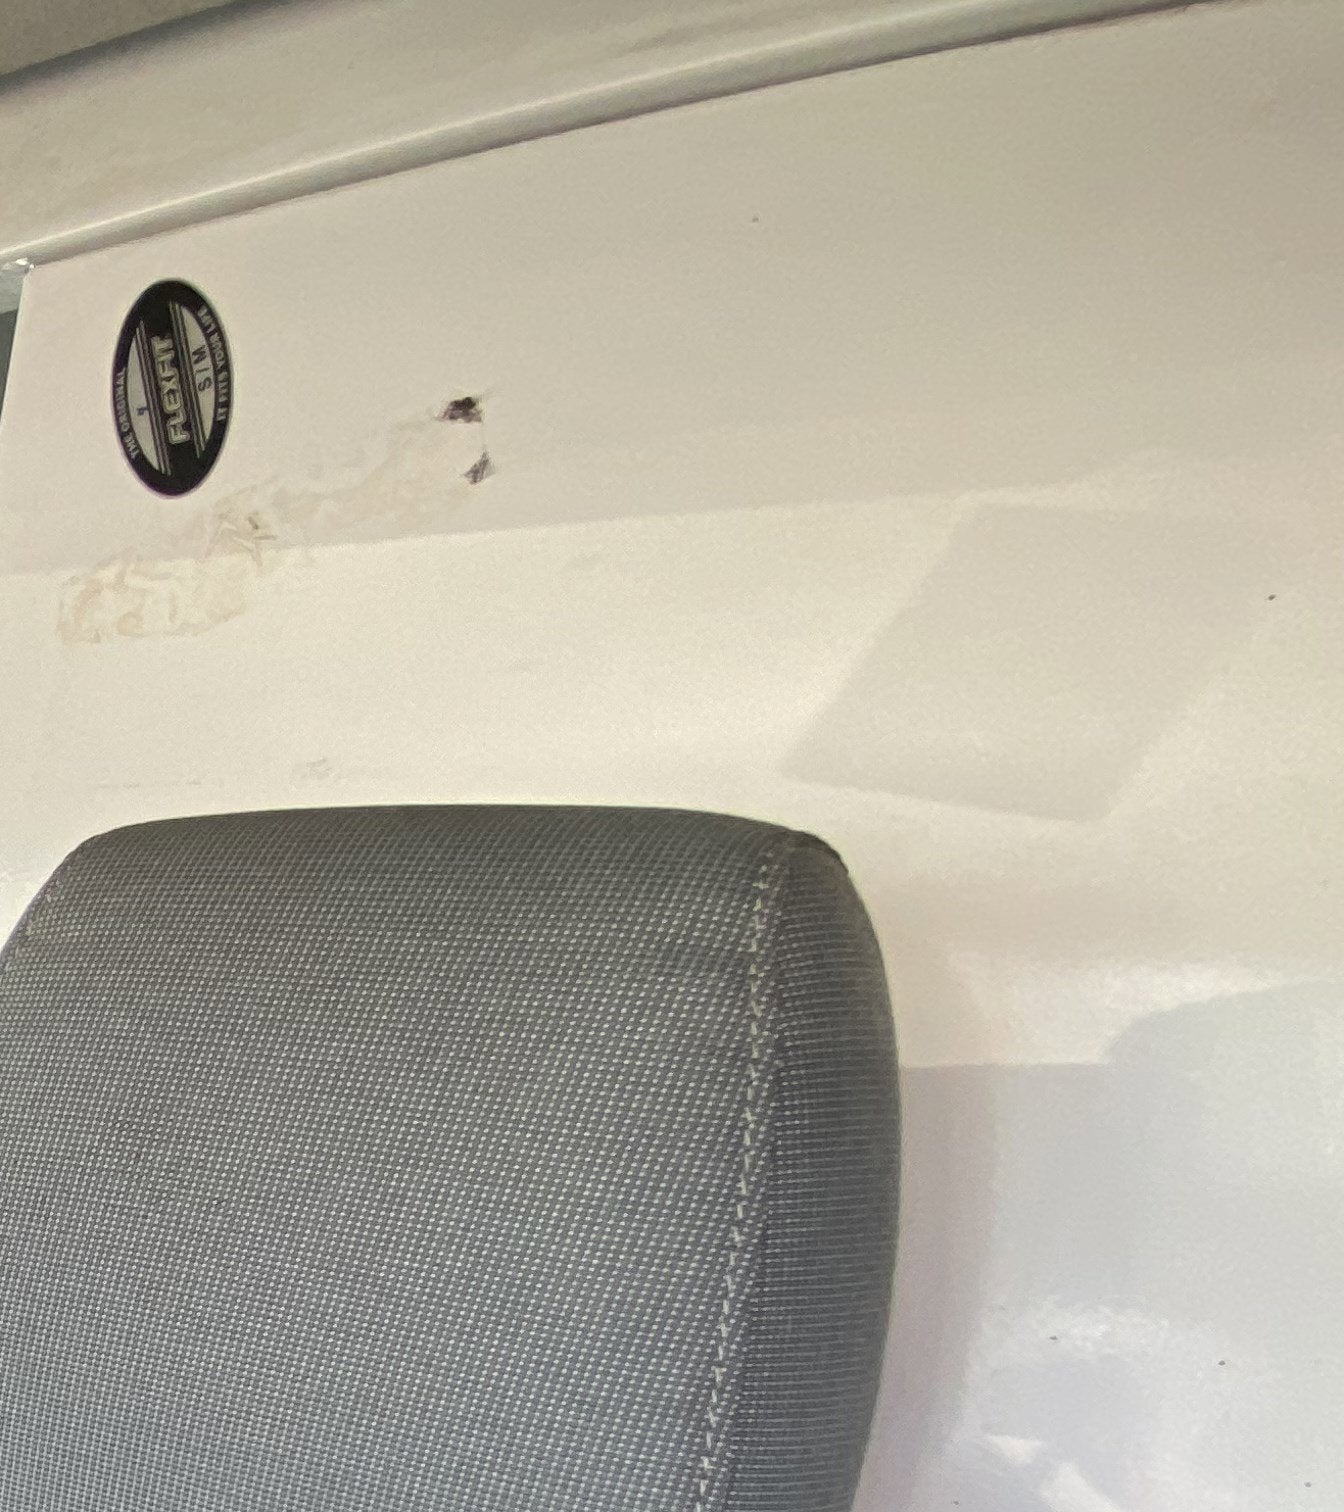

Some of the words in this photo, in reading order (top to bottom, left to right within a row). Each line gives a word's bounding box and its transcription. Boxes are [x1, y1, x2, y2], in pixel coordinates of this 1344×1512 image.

[209, 332, 226, 370] YOUR
[115, 367, 131, 433] ORIGINAL
[151, 334, 192, 446] FLEXFIT
[125, 433, 141, 459] THE
